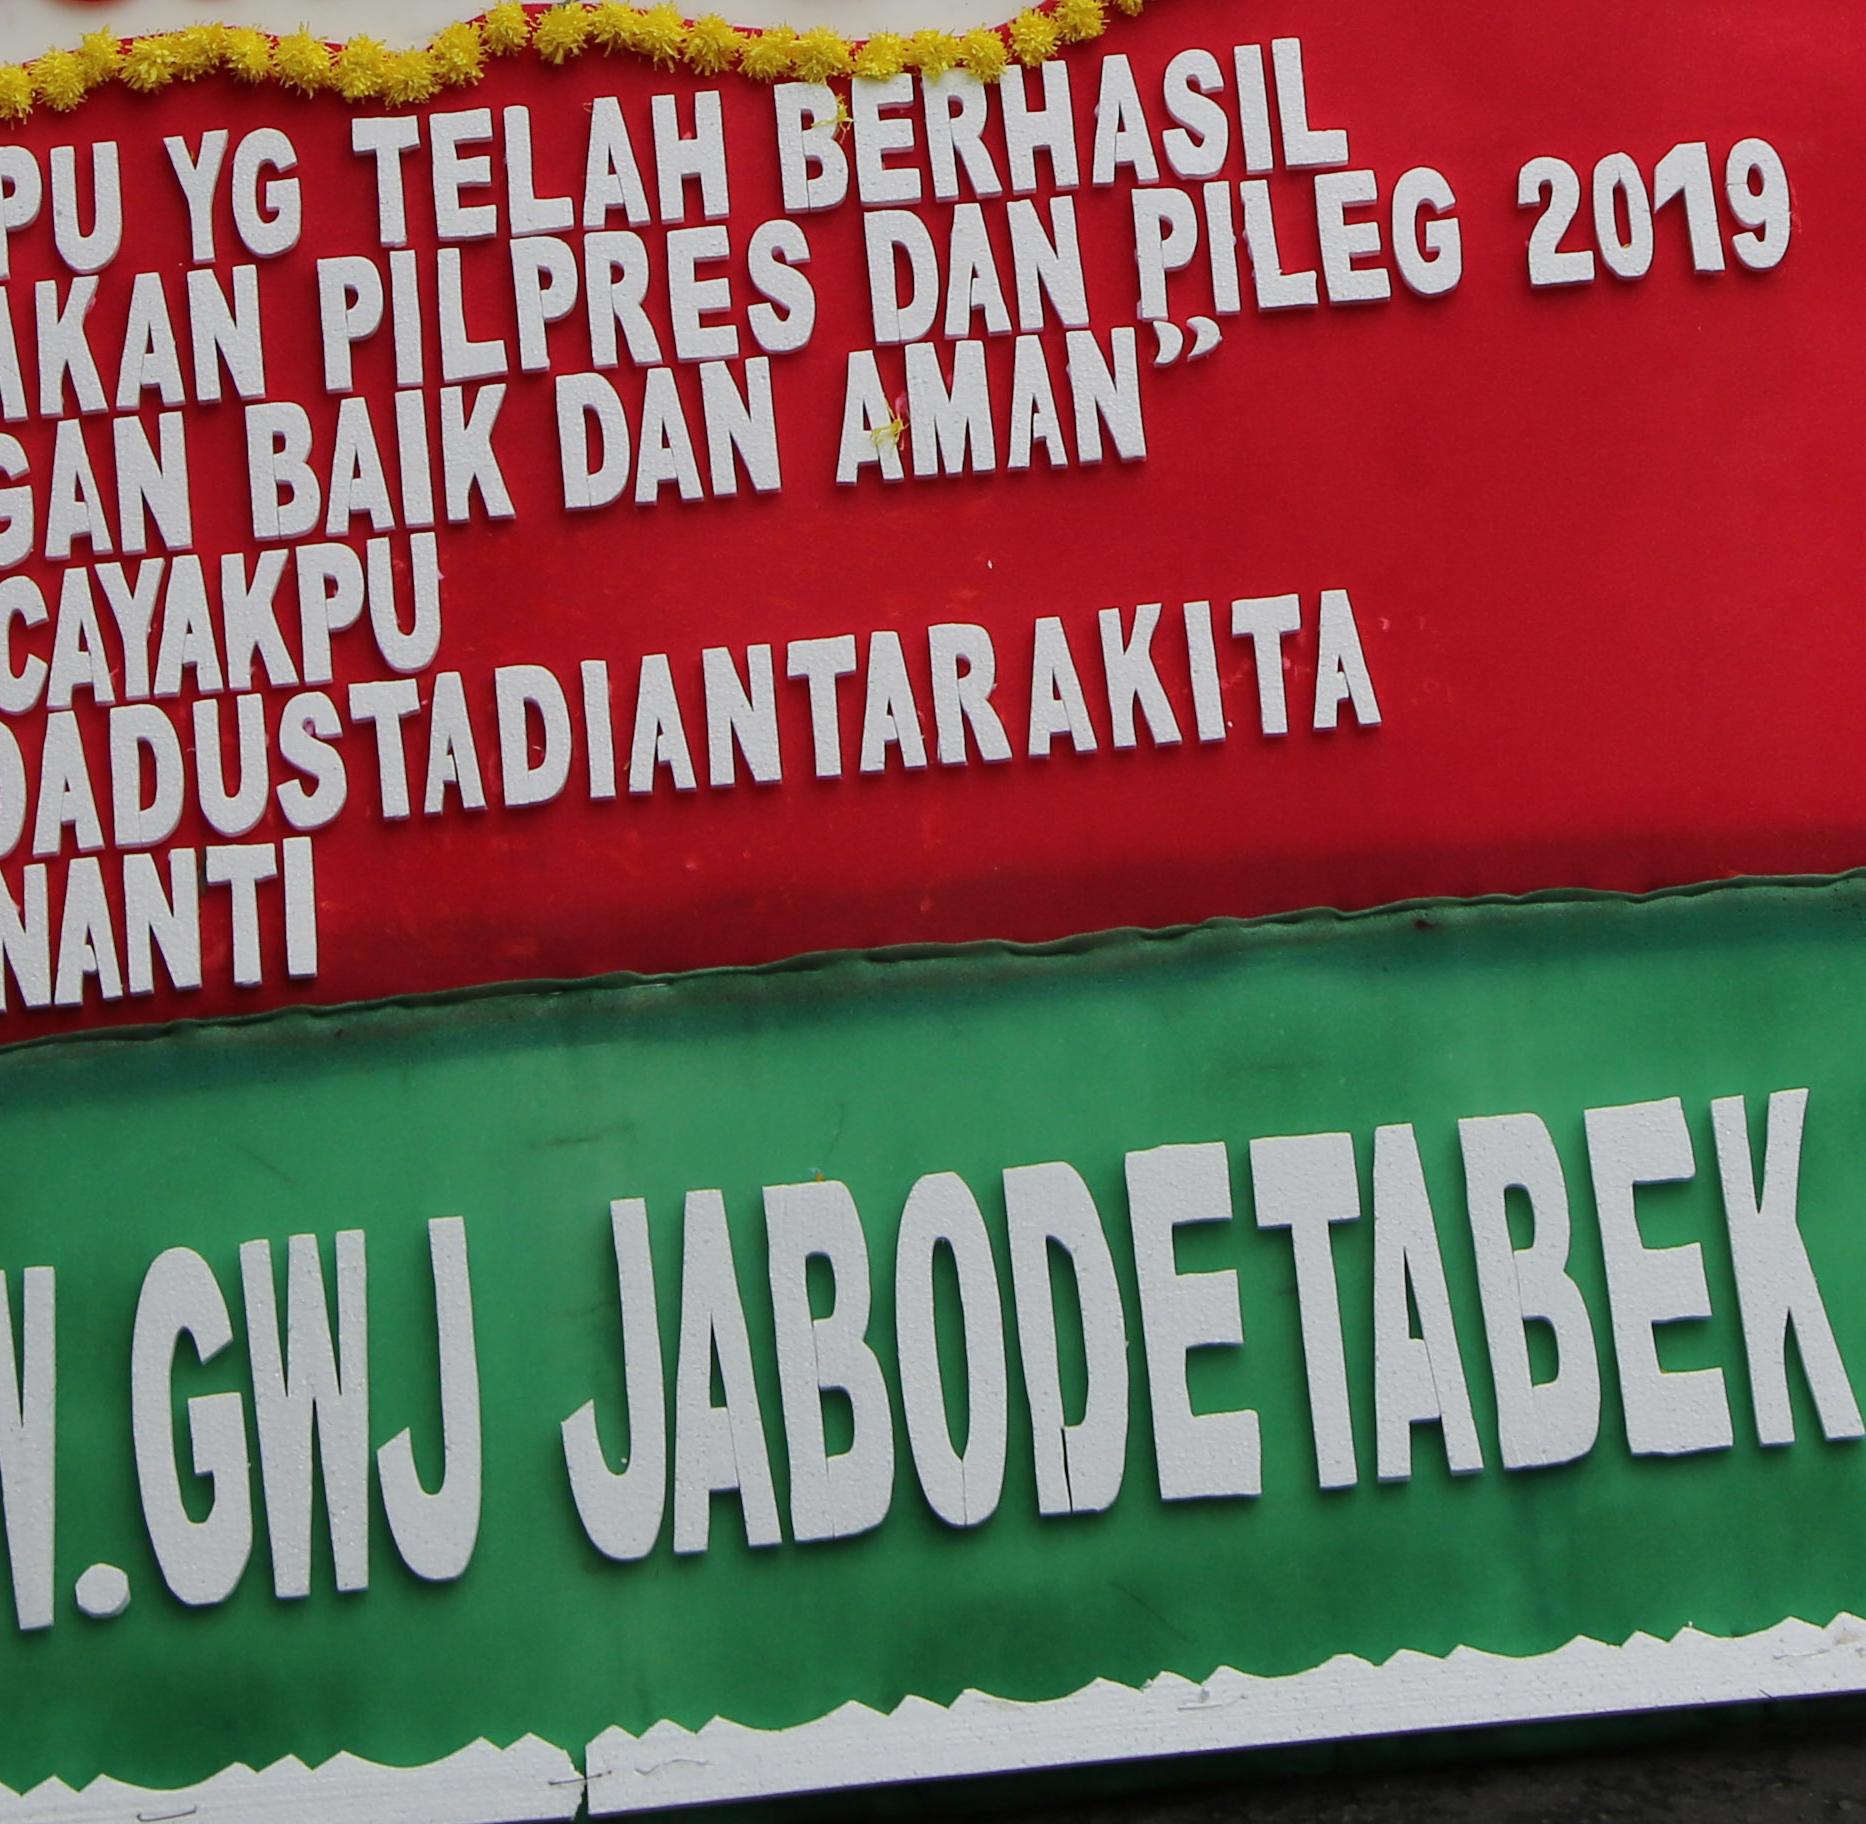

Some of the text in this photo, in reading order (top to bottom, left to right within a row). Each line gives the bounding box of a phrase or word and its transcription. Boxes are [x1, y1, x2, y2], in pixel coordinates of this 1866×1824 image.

[165, 127, 302, 262] YG
[351, 90, 730, 246] TELAH
[773, 37, 1348, 215] BERHASIL
[316, 221, 816, 392] PILPRES
[863, 195, 1090, 347] DAN
[1132, 166, 1463, 325] PILEG
[1517, 138, 1792, 287] 2019
[244, 383, 516, 542] BAIK
[555, 355, 782, 511] DAN
[562, 1087, 1865, 1564] JABODETABEK
